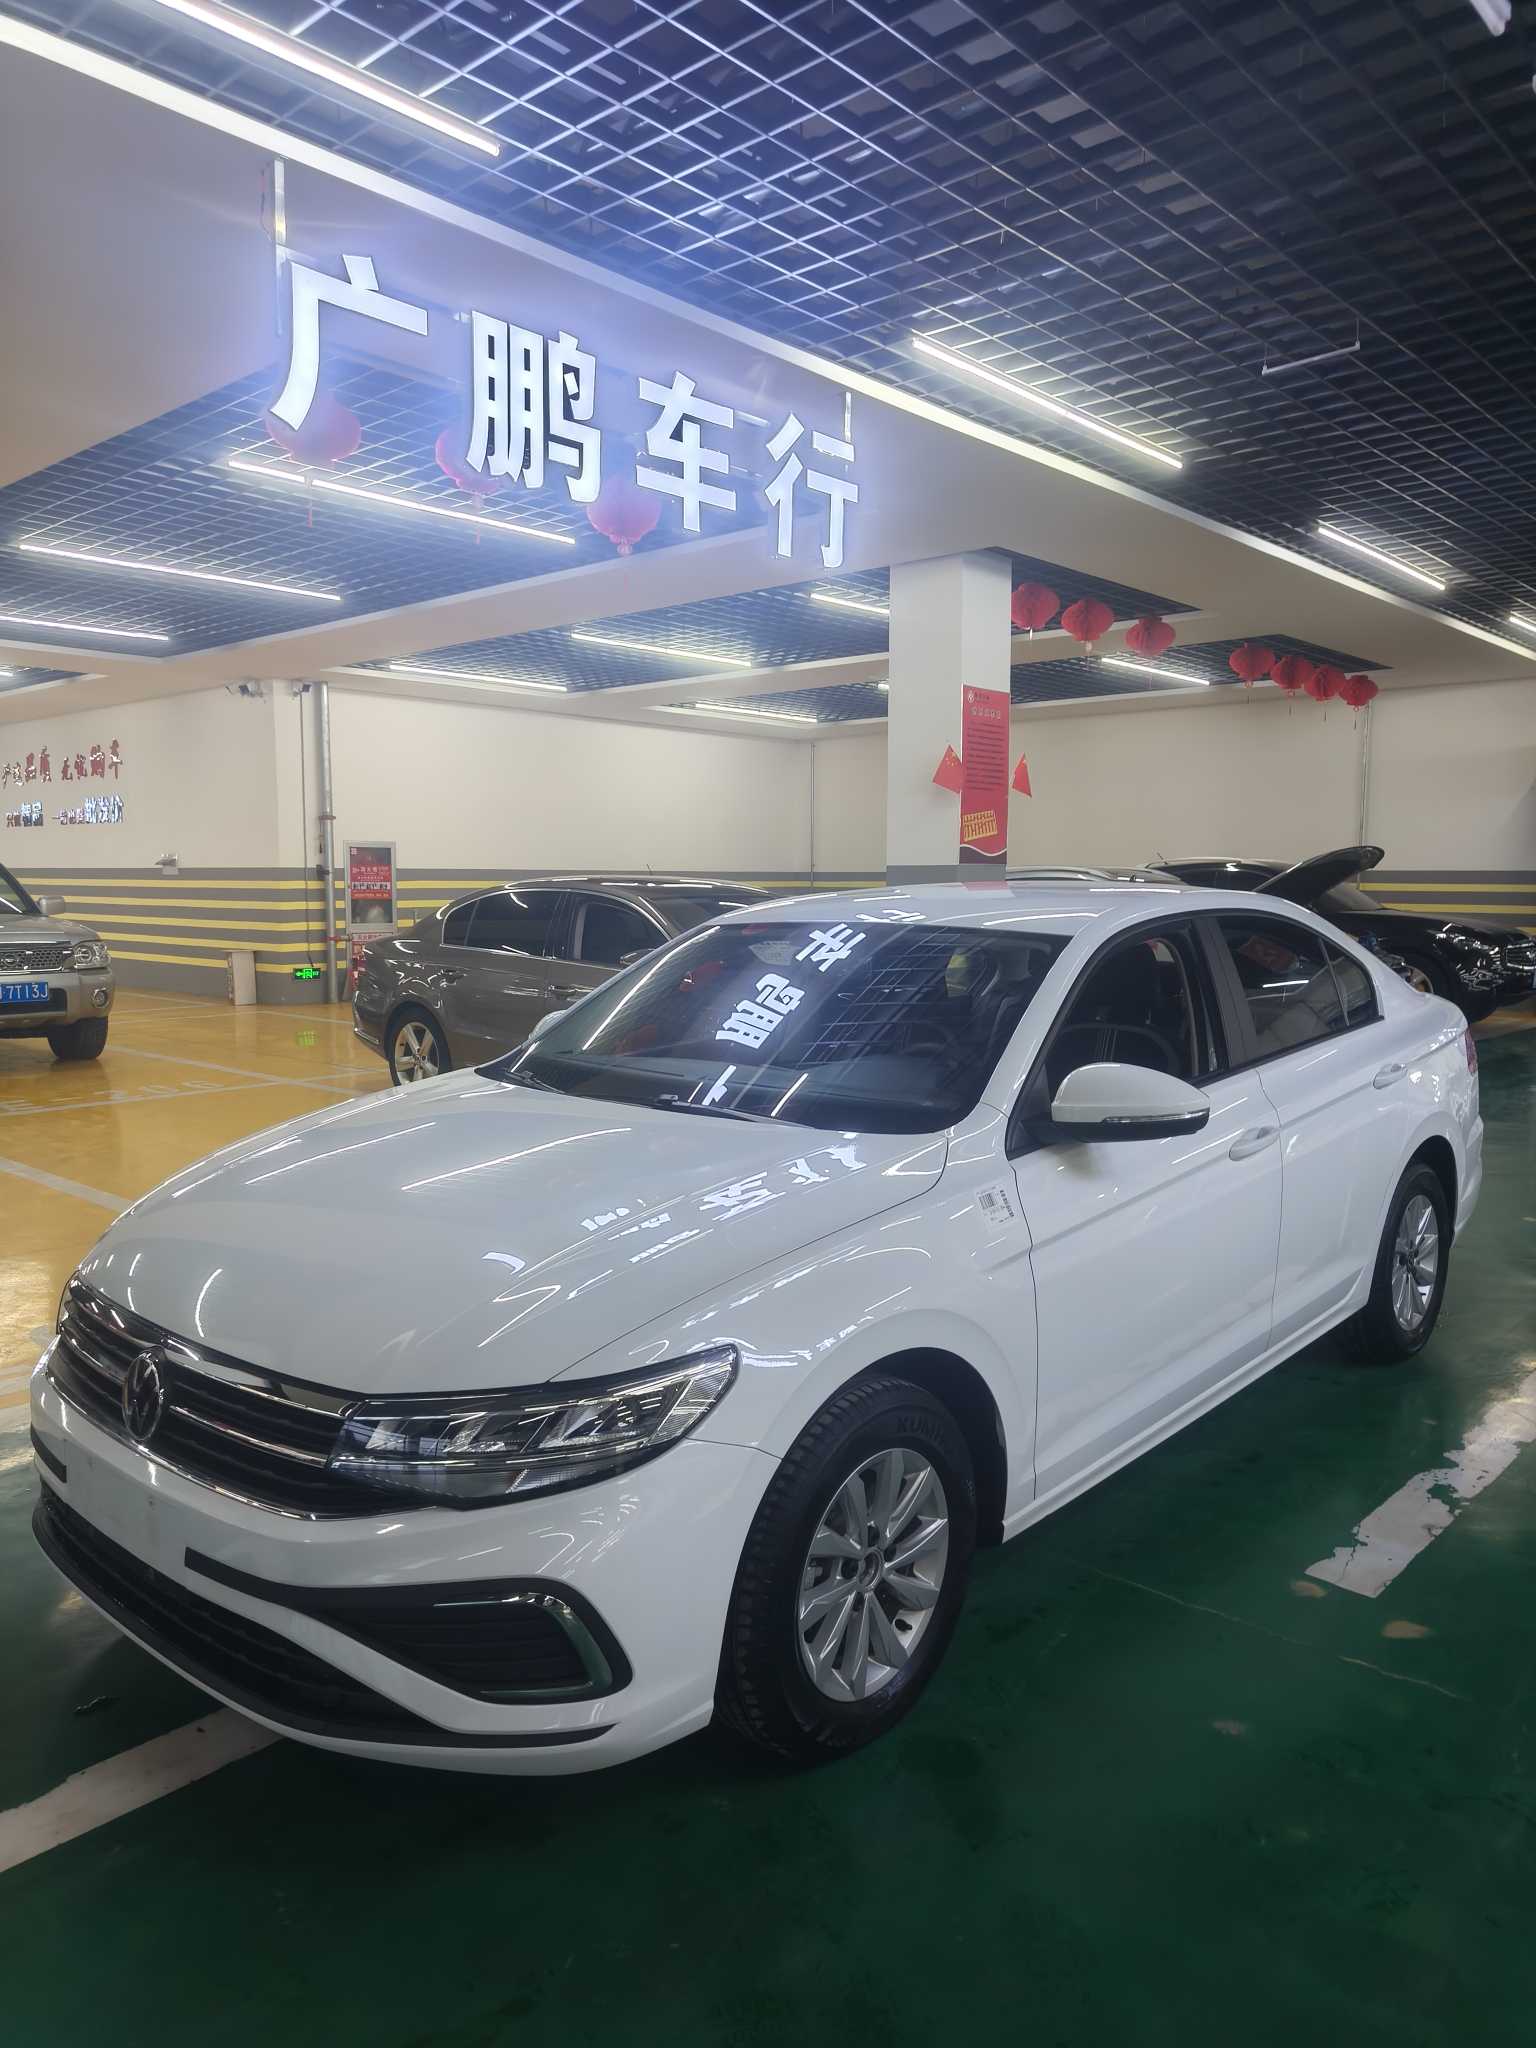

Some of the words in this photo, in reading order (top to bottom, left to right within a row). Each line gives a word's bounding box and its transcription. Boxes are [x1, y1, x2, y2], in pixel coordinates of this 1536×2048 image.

[270, 253, 860, 569] 广鹏车行
[0, 983, 49, 1000] 7T13J
